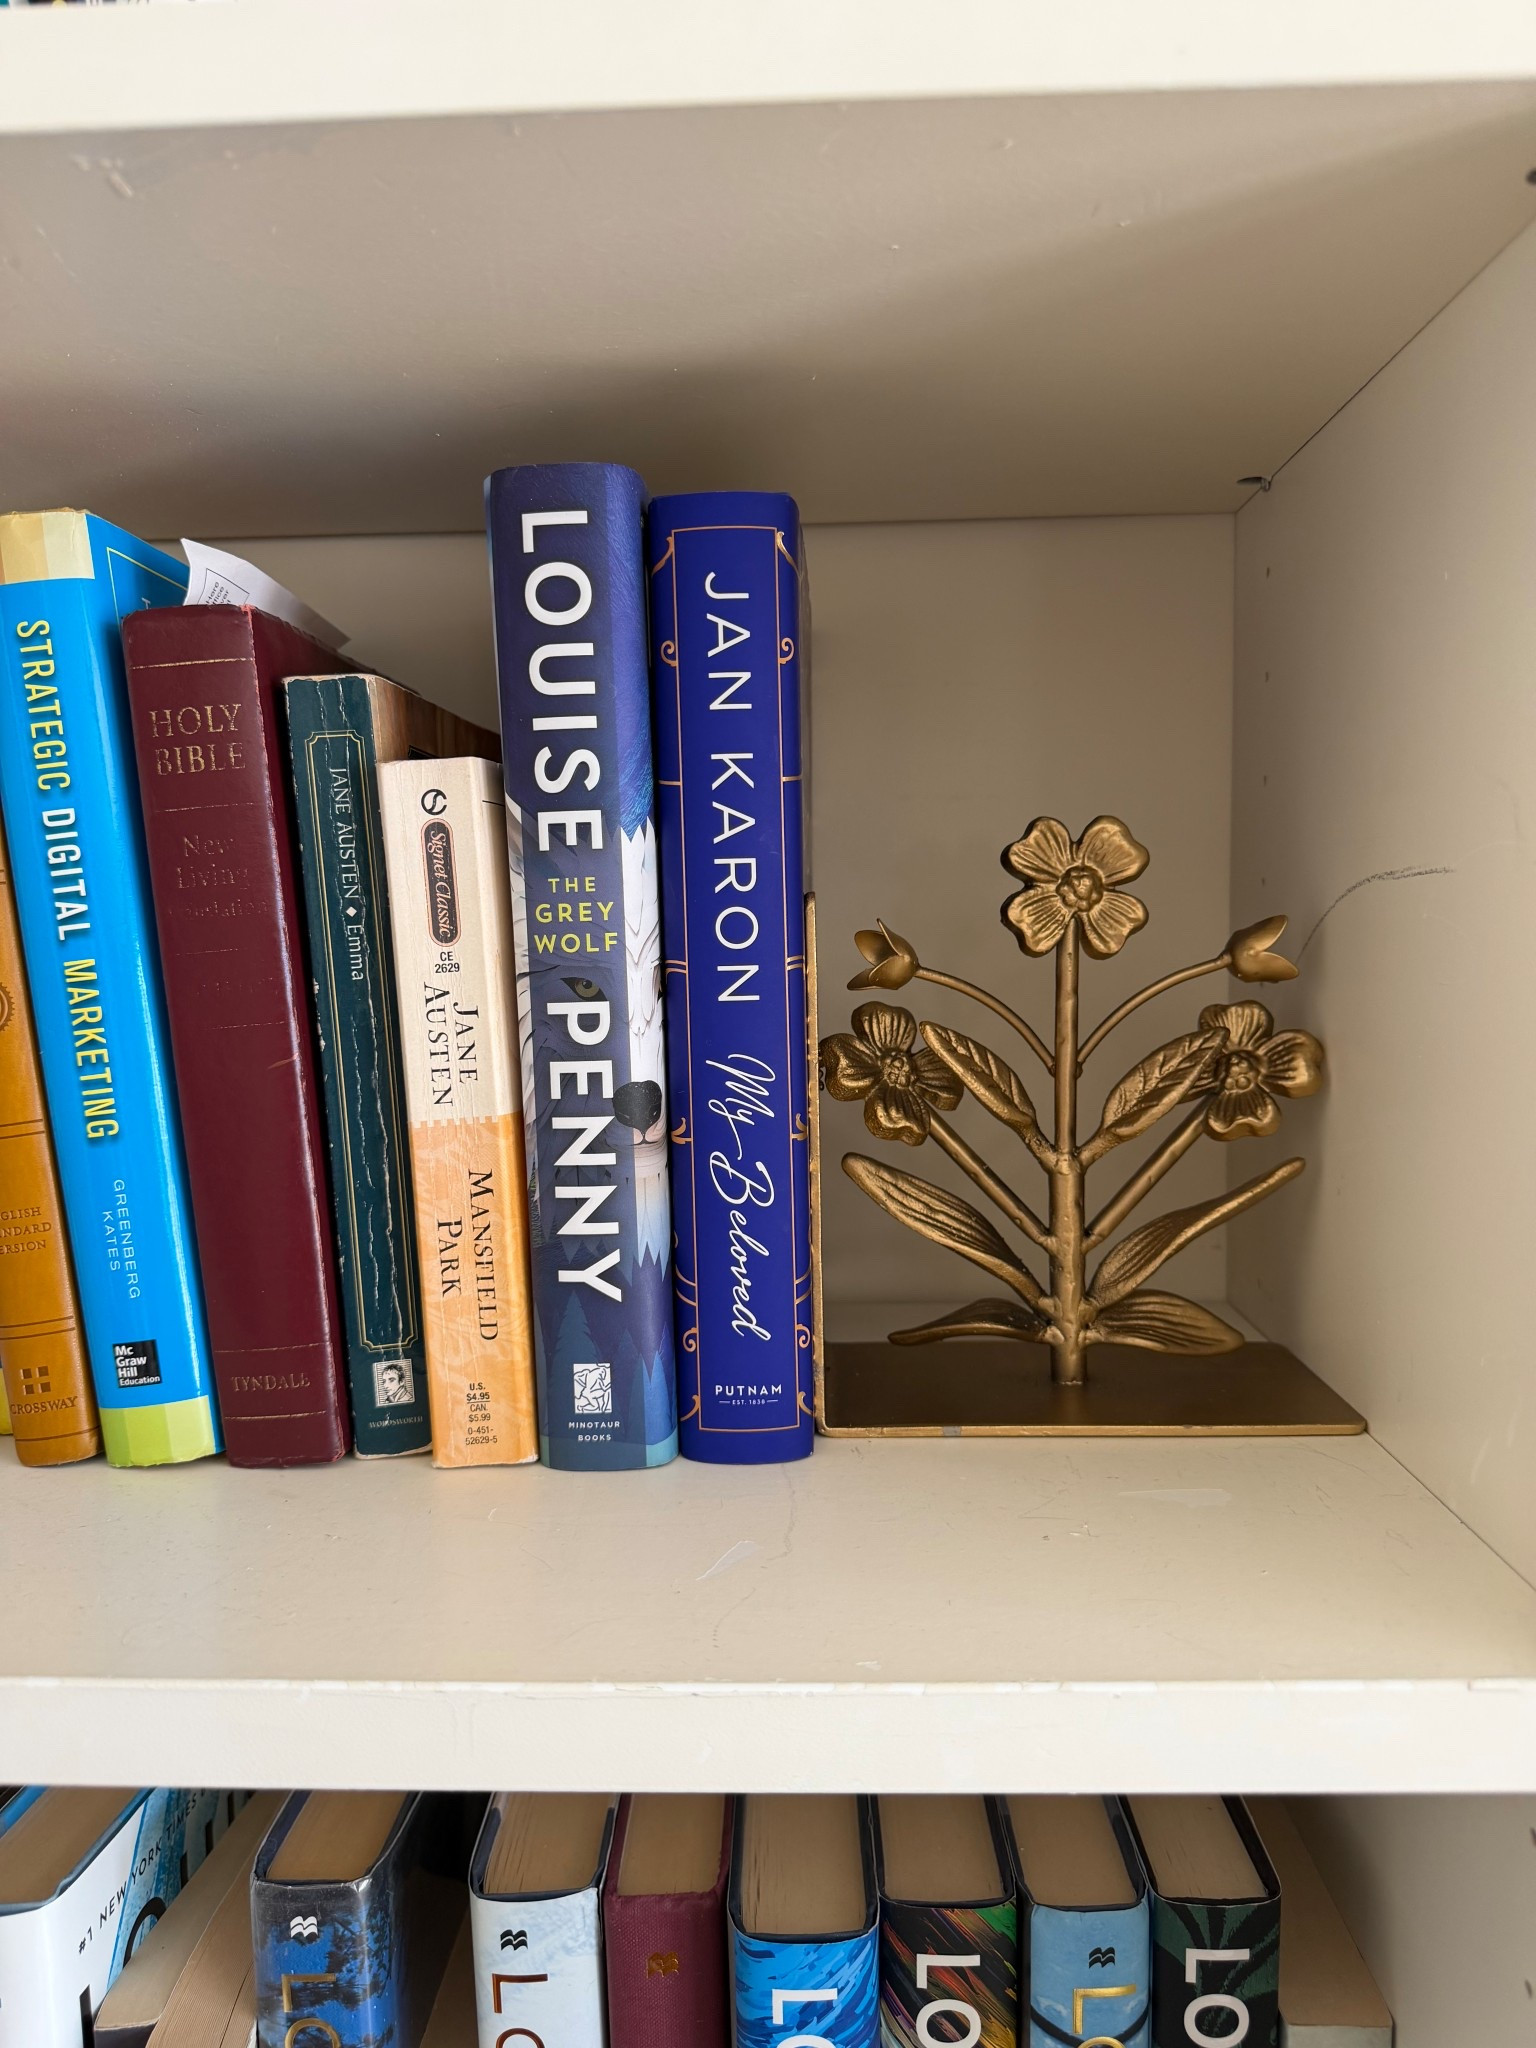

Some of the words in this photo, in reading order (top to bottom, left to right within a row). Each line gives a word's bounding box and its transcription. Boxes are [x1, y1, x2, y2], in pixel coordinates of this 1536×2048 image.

[704, 571, 753, 711] JAN
[521, 510, 604, 852] LOUISE
[16, 620, 72, 791] STRATEGIC
[149, 703, 242, 738] HOLY
[155, 742, 247, 776] BIBLE
[329, 768, 352, 814] JANE
[42, 807, 91, 941] DIGITAL
[336, 822, 360, 899] AUSTEN
[427, 830, 448, 881] Signet
[710, 752, 760, 1003] KARON
[547, 877, 596, 893] THE
[435, 881, 453, 938] Classic
[535, 901, 615, 923] GREY
[346, 924, 365, 980] Emma
[440, 951, 454, 961] CE
[533, 932, 619, 954] WOLF
[434, 963, 461, 974] 2629
[63, 958, 120, 1139] MARKETING
[423, 981, 453, 1107] AUSTEN
[453, 1002, 480, 1085] JANE
[705, 1053, 776, 1160] My
[546, 1000, 622, 1302] PENNY
[0, 1222, 52, 1238] NDARD
[102, 1210, 121, 1272] KATES
[113, 1179, 142, 1300] GREENBERG
[709, 1150, 776, 1342] Beloved
[436, 1216, 463, 1298] PARK
[468, 1168, 499, 1341] MANSFIELD
[115, 1345, 134, 1356] Mc
[116, 1356, 147, 1367] Graw
[118, 1366, 138, 1378] Hill
[119, 1376, 161, 1386] Education
[231, 1373, 311, 1392] TYNDALL
[466, 1392, 490, 1401] $4.95
[469, 1382, 486, 1391] U.S.
[715, 1384, 782, 1396] PUTNAM
[10, 1396, 78, 1415] CROSSWAY
[468, 1413, 491, 1423] $5.99
[568, 1421, 621, 1429] MINOTAUR
[465, 1436, 498, 1445] 52629-5
[467, 1426, 494, 1435] 0-451-
[78, 1926, 93, 1954] #1
[99, 1881, 127, 1929] NEW
[131, 1838, 162, 1885] YORK
[165, 1797, 197, 1839] TIMES
[916, 1953, 982, 2048] LO
[1184, 1948, 1250, 2047] LO
